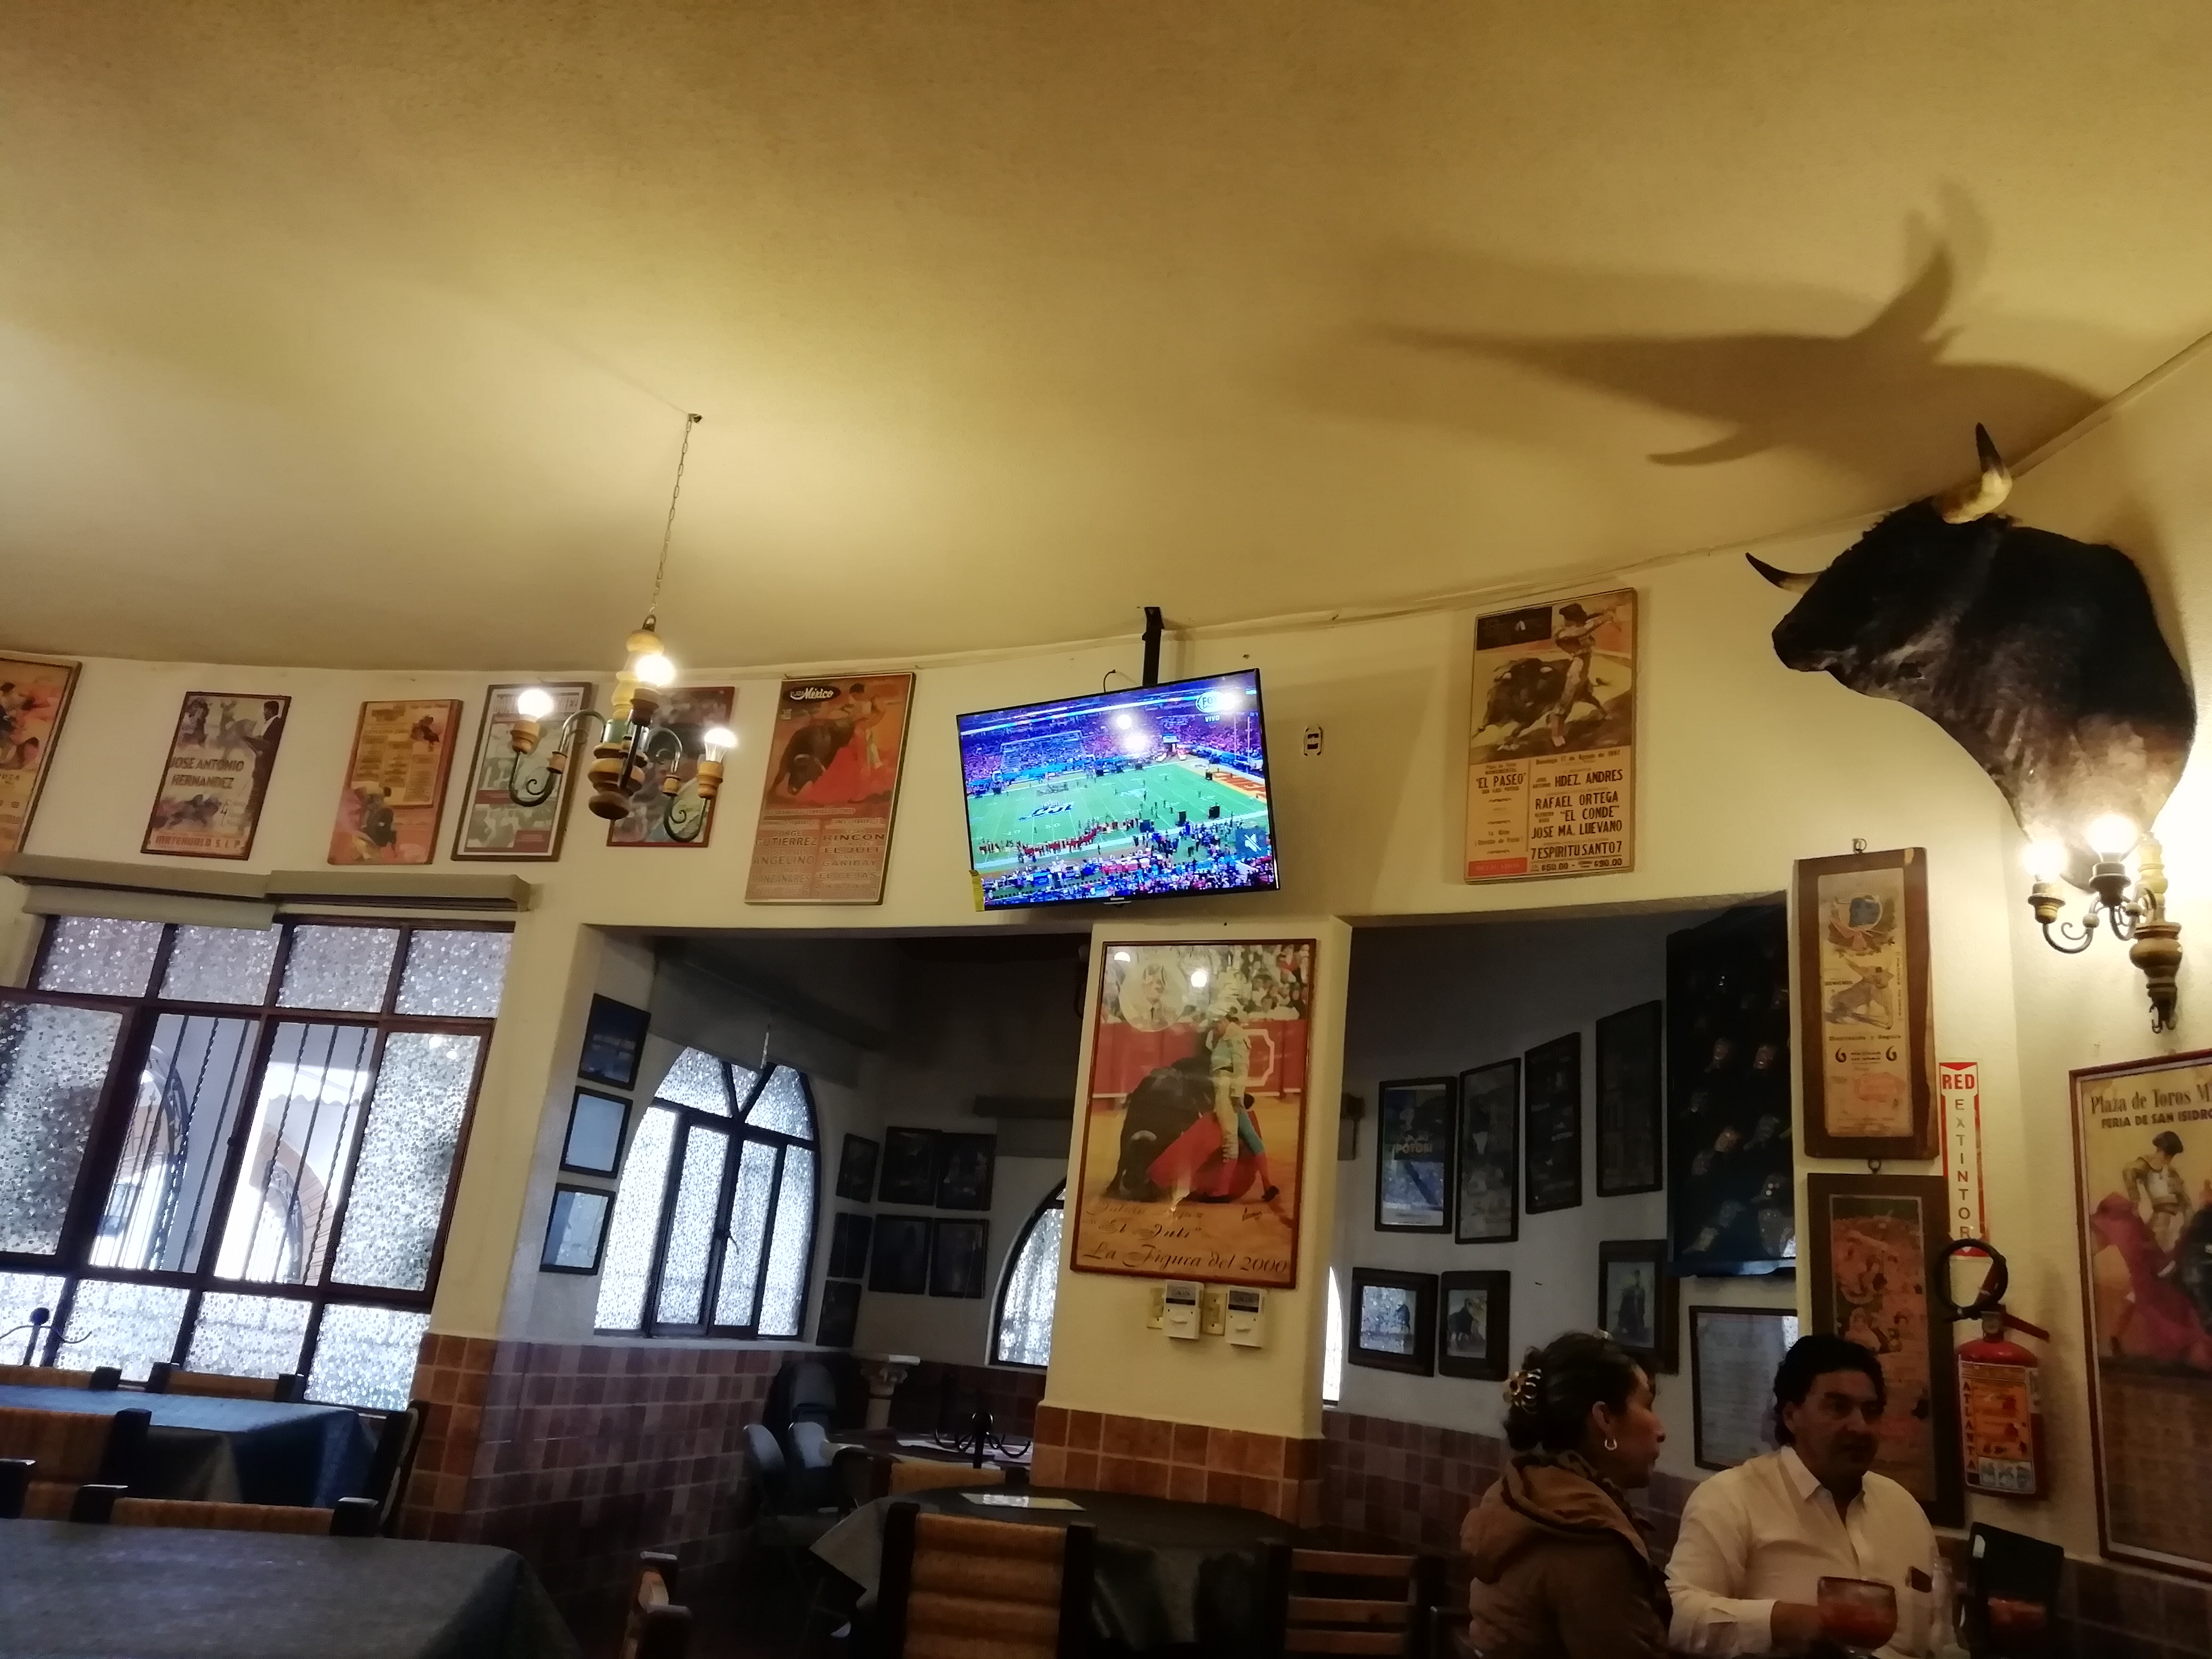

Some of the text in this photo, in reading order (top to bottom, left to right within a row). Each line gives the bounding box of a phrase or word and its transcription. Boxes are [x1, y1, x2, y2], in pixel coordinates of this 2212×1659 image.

[171, 757, 244, 772] JOSE ANTONIO
[171, 774, 234, 790] HERNANDEZ
[1586, 769, 1623, 784] ANDRES
[1535, 795, 1572, 810] RAFAEL
[1579, 791, 1619, 806] ORTEGA
[1531, 826, 1554, 840] JOSE
[1579, 819, 1623, 835] LUEVANO
[756, 837, 817, 847] GUTIERREZ
[1530, 840, 1622, 860] 7 ESPIRITU SANTO 7
[752, 856, 815, 865] ANGELINO
[1835, 1046, 1847, 1063] 6
[1886, 1045, 1897, 1062] 6
[1942, 1074, 1975, 1090] RED
[2090, 1095, 2127, 1114] Plaza
[2132, 1091, 2148, 1110] de
[2152, 1089, 2191, 1108] Toros
[2102, 1116, 2132, 1128] FERIA
[2135, 1115, 2148, 1126] DE
[2152, 1112, 2174, 1124] SAN
[1955, 1099, 1971, 1239] EXTINTOR
[1083, 1241, 1288, 1273] La Figura del 2000
